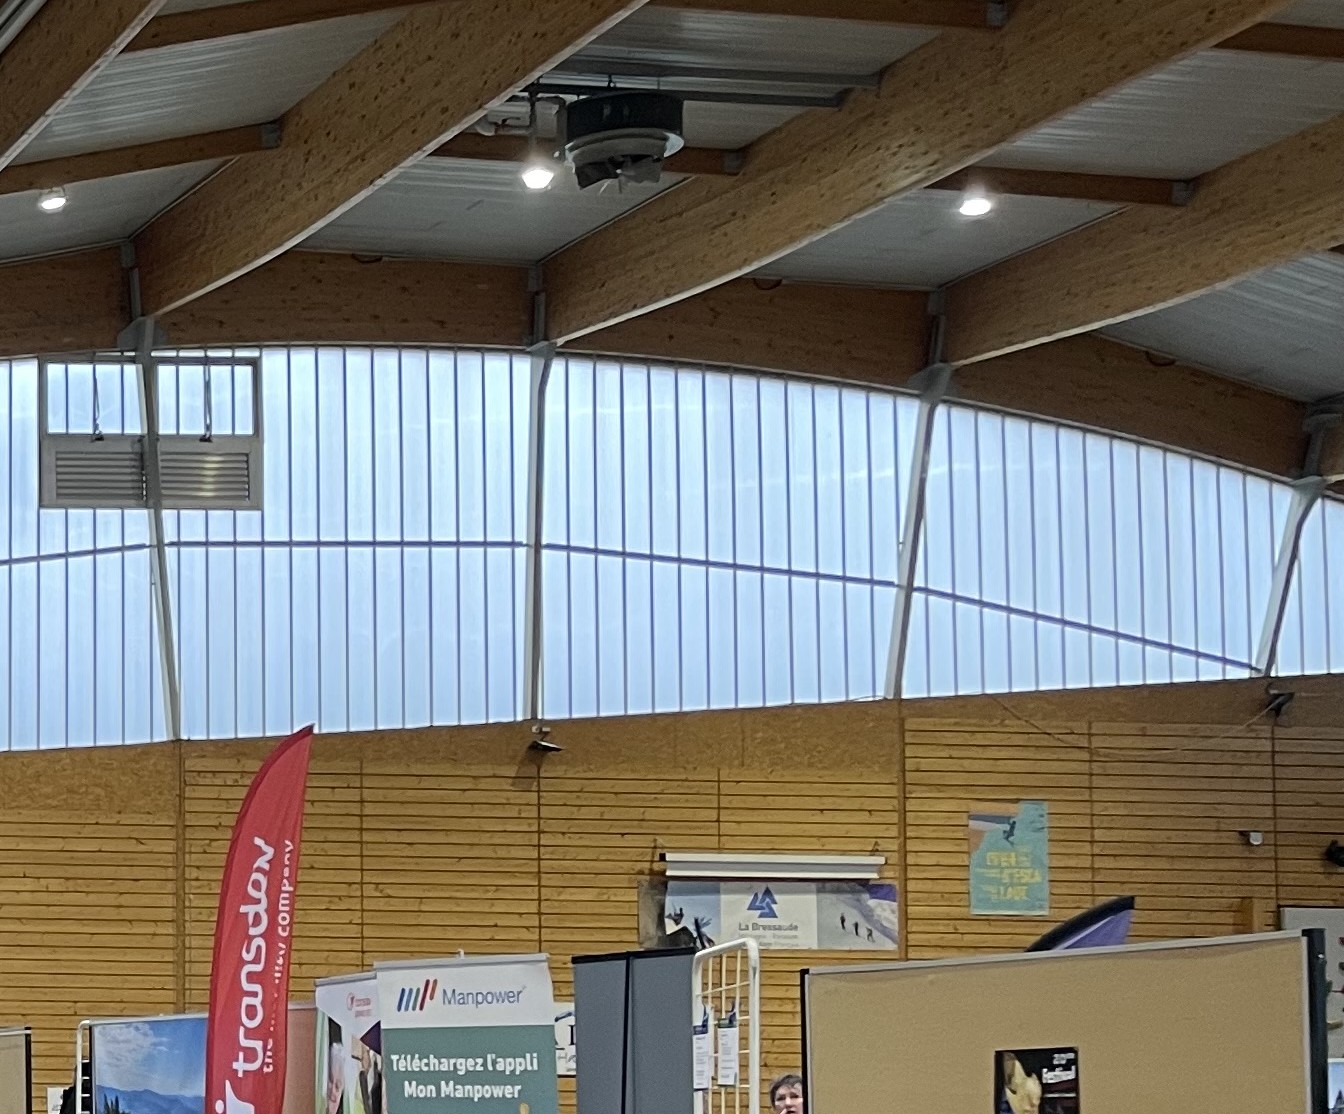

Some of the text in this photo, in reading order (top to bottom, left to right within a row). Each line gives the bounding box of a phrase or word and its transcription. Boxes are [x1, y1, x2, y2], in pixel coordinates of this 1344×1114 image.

[232, 836, 275, 1077] transdev
[442, 986, 524, 1008] Manpower
[390, 1052, 539, 1075] Téléchargez l'appli
[404, 1080, 521, 1102] Mon Manpower
